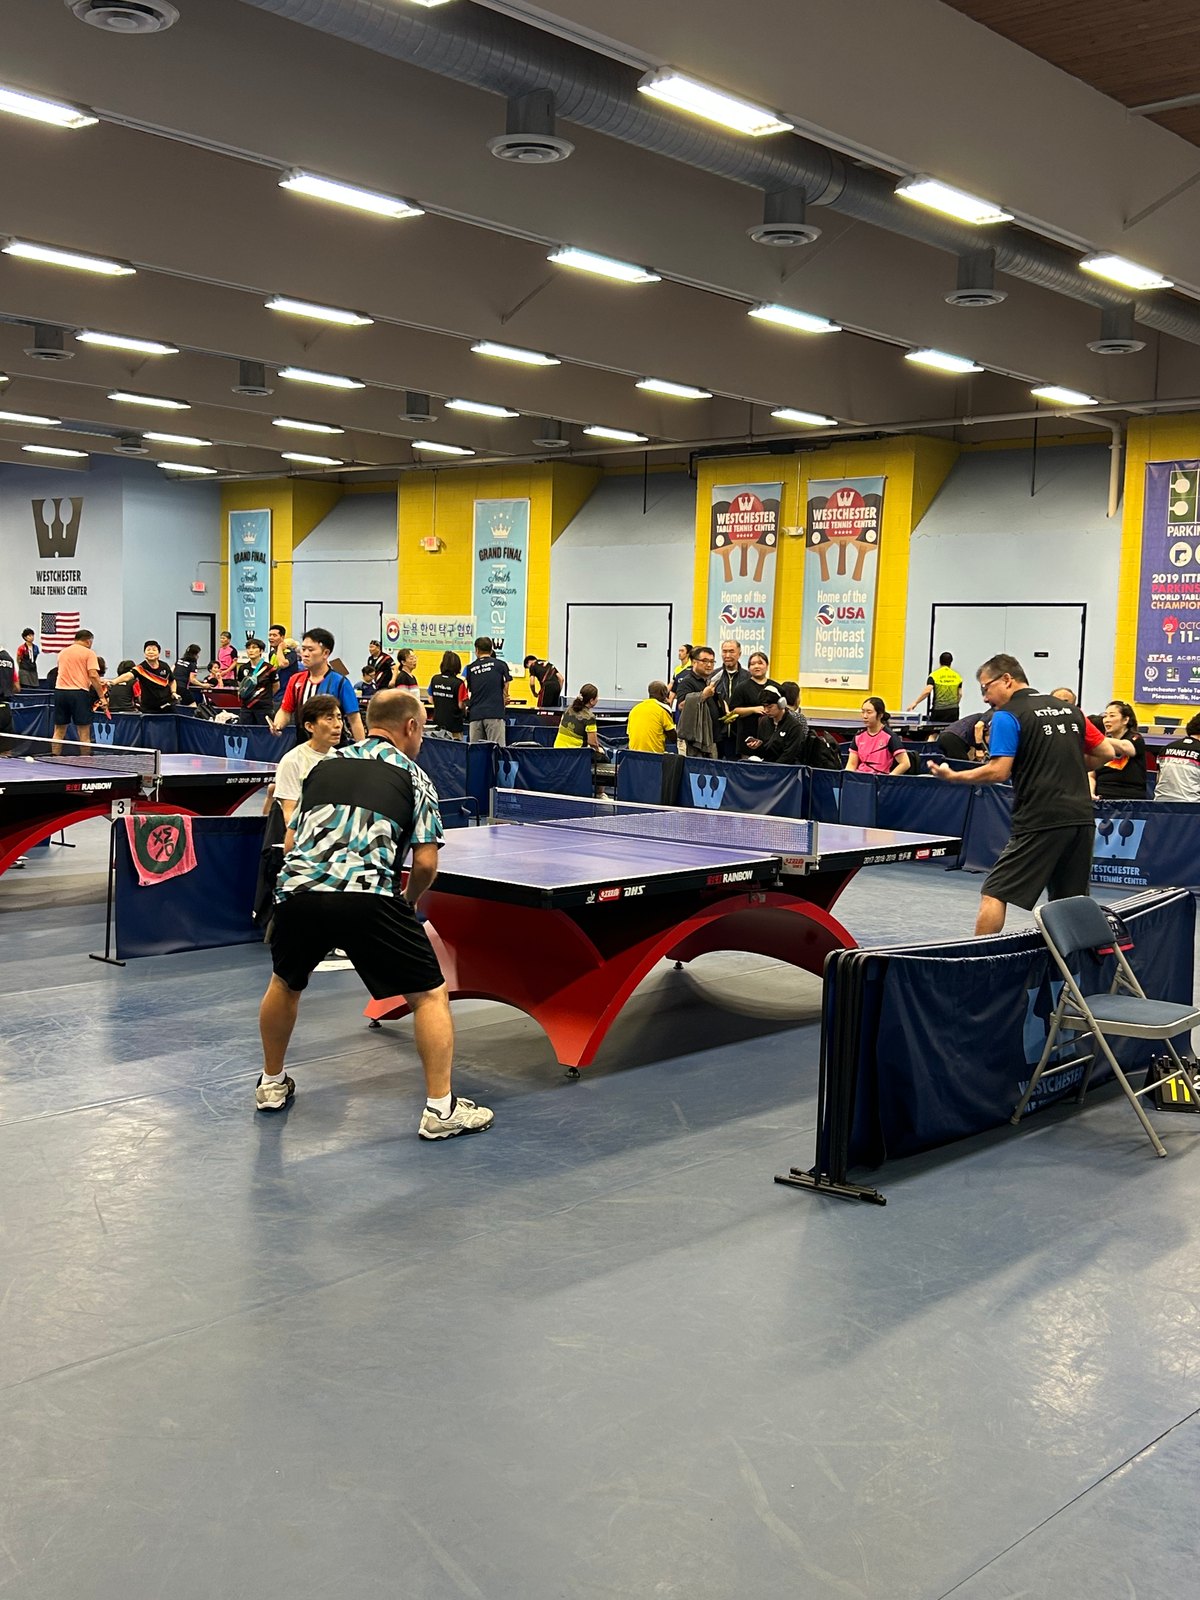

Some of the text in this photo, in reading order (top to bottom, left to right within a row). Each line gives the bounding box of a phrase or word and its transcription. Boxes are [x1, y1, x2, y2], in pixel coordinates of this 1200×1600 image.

[717, 511, 775, 524] WESTCHESTER
[813, 507, 877, 520] WESTCHESTER
[717, 524, 775, 533] TABLE TENNIS CENTER
[813, 520, 876, 529] TABLE TENNIS CENTER
[234, 551, 266, 564] GRAND FINAL
[479, 547, 522, 562] GRAND FINAL
[36, 570, 81, 582] WESTCHESTER
[488, 571, 511, 583] North
[1152, 574, 1179, 583] 2019
[30, 586, 87, 595] TABLE TENNIS CENTER
[481, 585, 517, 595] American
[490, 596, 507, 607] Tour
[721, 591, 766, 603] Home of the
[818, 590, 867, 603] Home of the
[740, 607, 765, 619] USA
[837, 607, 865, 619] USA
[403, 622, 473, 637] 뉴욕 한인 탁구 협회
[720, 625, 765, 640] Northeast
[816, 626, 865, 642] Northeast
[815, 642, 864, 661] Regionals
[1186, 750, 1199, 759] LEE
[82, 782, 112, 790] RAINBOW
[117, 801, 125, 814] 3
[723, 870, 753, 883] RAINBOW
[1099, 875, 1122, 884] TENNIS
[1124, 877, 1147, 885] CENTER
[623, 885, 646, 897] DHS
